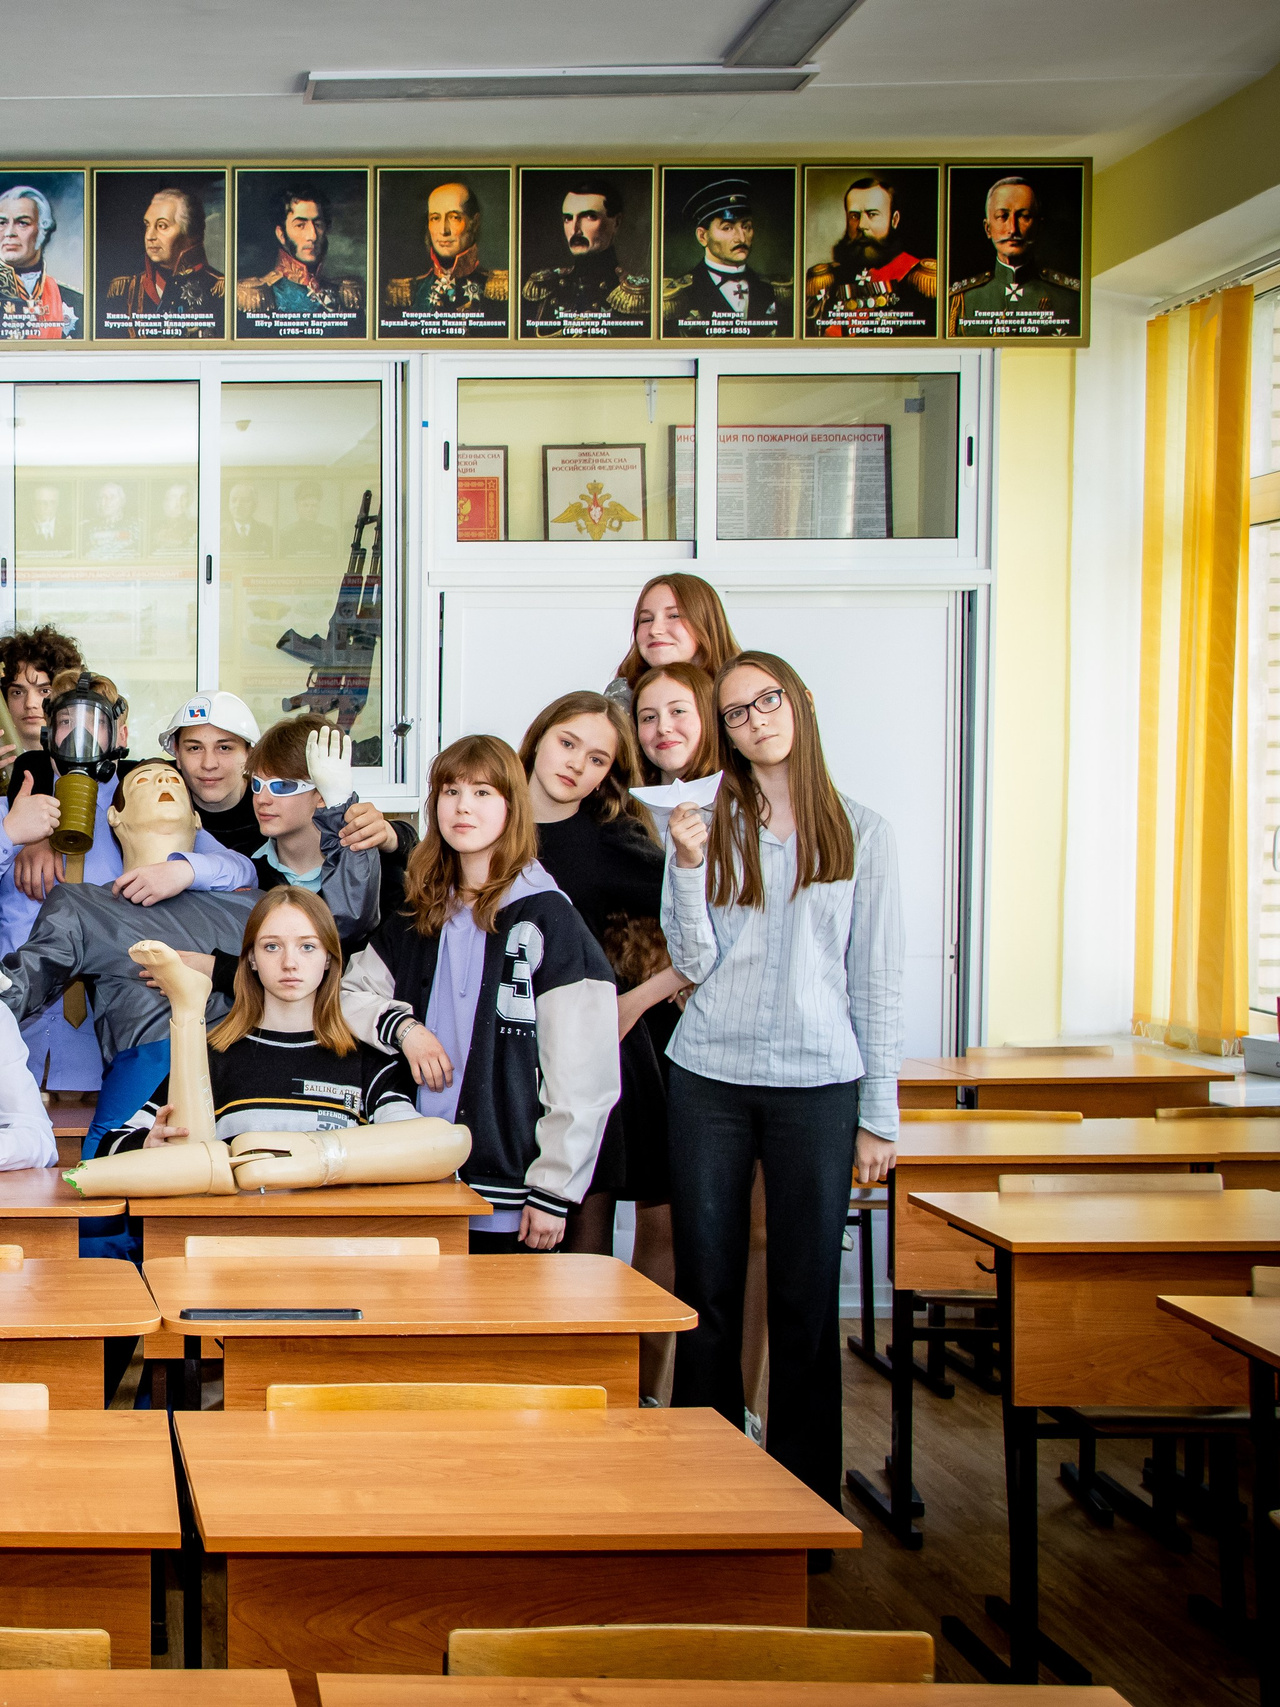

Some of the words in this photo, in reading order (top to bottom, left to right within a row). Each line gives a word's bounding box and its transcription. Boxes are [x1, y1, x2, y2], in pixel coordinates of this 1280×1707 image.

[2, 321, 24, 329] Федор
[26, 321, 65, 329] Федорович
[104, 320, 133, 328] Кутузов
[134, 320, 162, 328] Михаил
[163, 320, 216, 328] Илларионович
[757, 433, 808, 442] ПОЖАРНОЙ
[811, 434, 884, 442] БЕЗОПАСНОСТИ
[496, 920, 544, 1024] 3
[500, 1026, 527, 1036] EST.
[305, 1084, 337, 1094] SAILING
